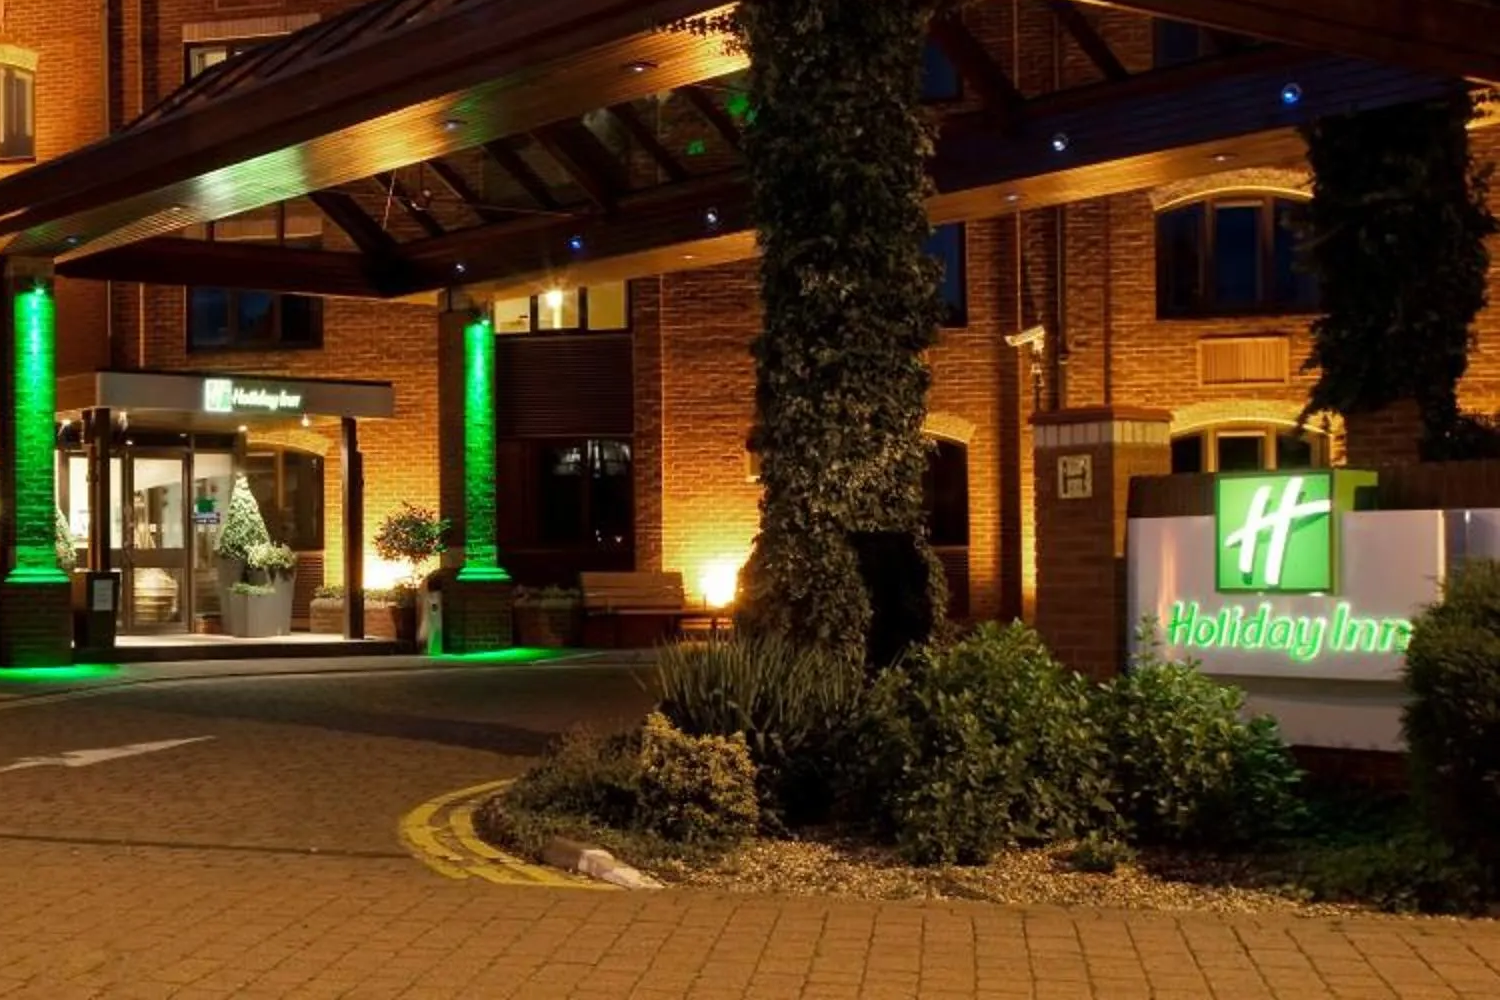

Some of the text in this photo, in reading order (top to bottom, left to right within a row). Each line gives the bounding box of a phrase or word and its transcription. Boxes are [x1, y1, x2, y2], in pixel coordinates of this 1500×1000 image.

[232, 387, 279, 411] Holiday
[1168, 600, 1412, 661] Holiday Inn
